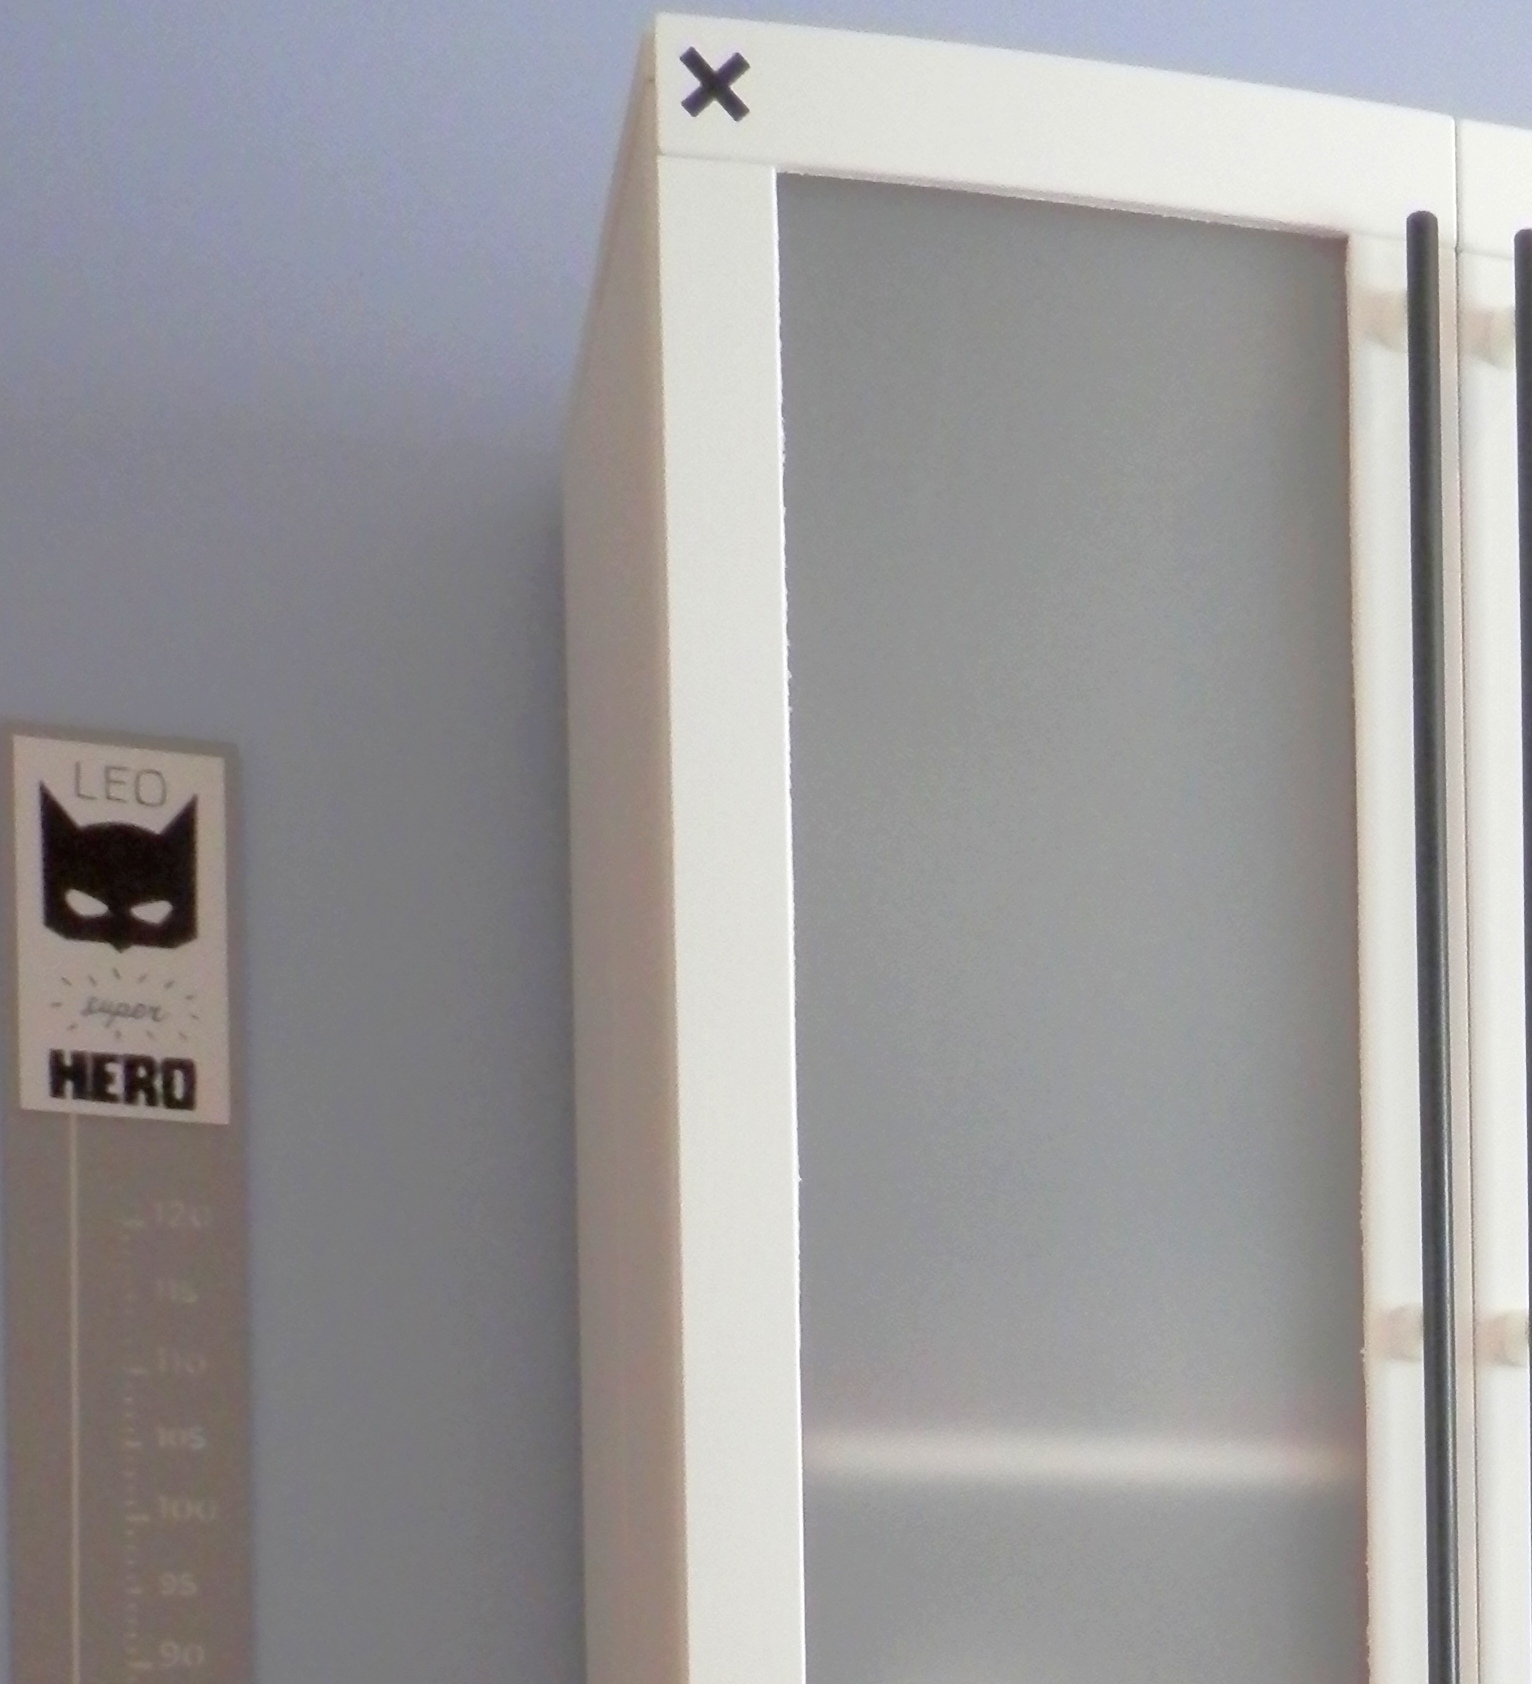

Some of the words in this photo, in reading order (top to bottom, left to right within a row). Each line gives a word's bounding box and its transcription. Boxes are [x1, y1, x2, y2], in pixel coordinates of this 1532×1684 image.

[73, 760, 168, 808] LEO
[48, 1048, 197, 1112] HERO
[158, 1571, 200, 1597] 95
[158, 1640, 206, 1669] 90
